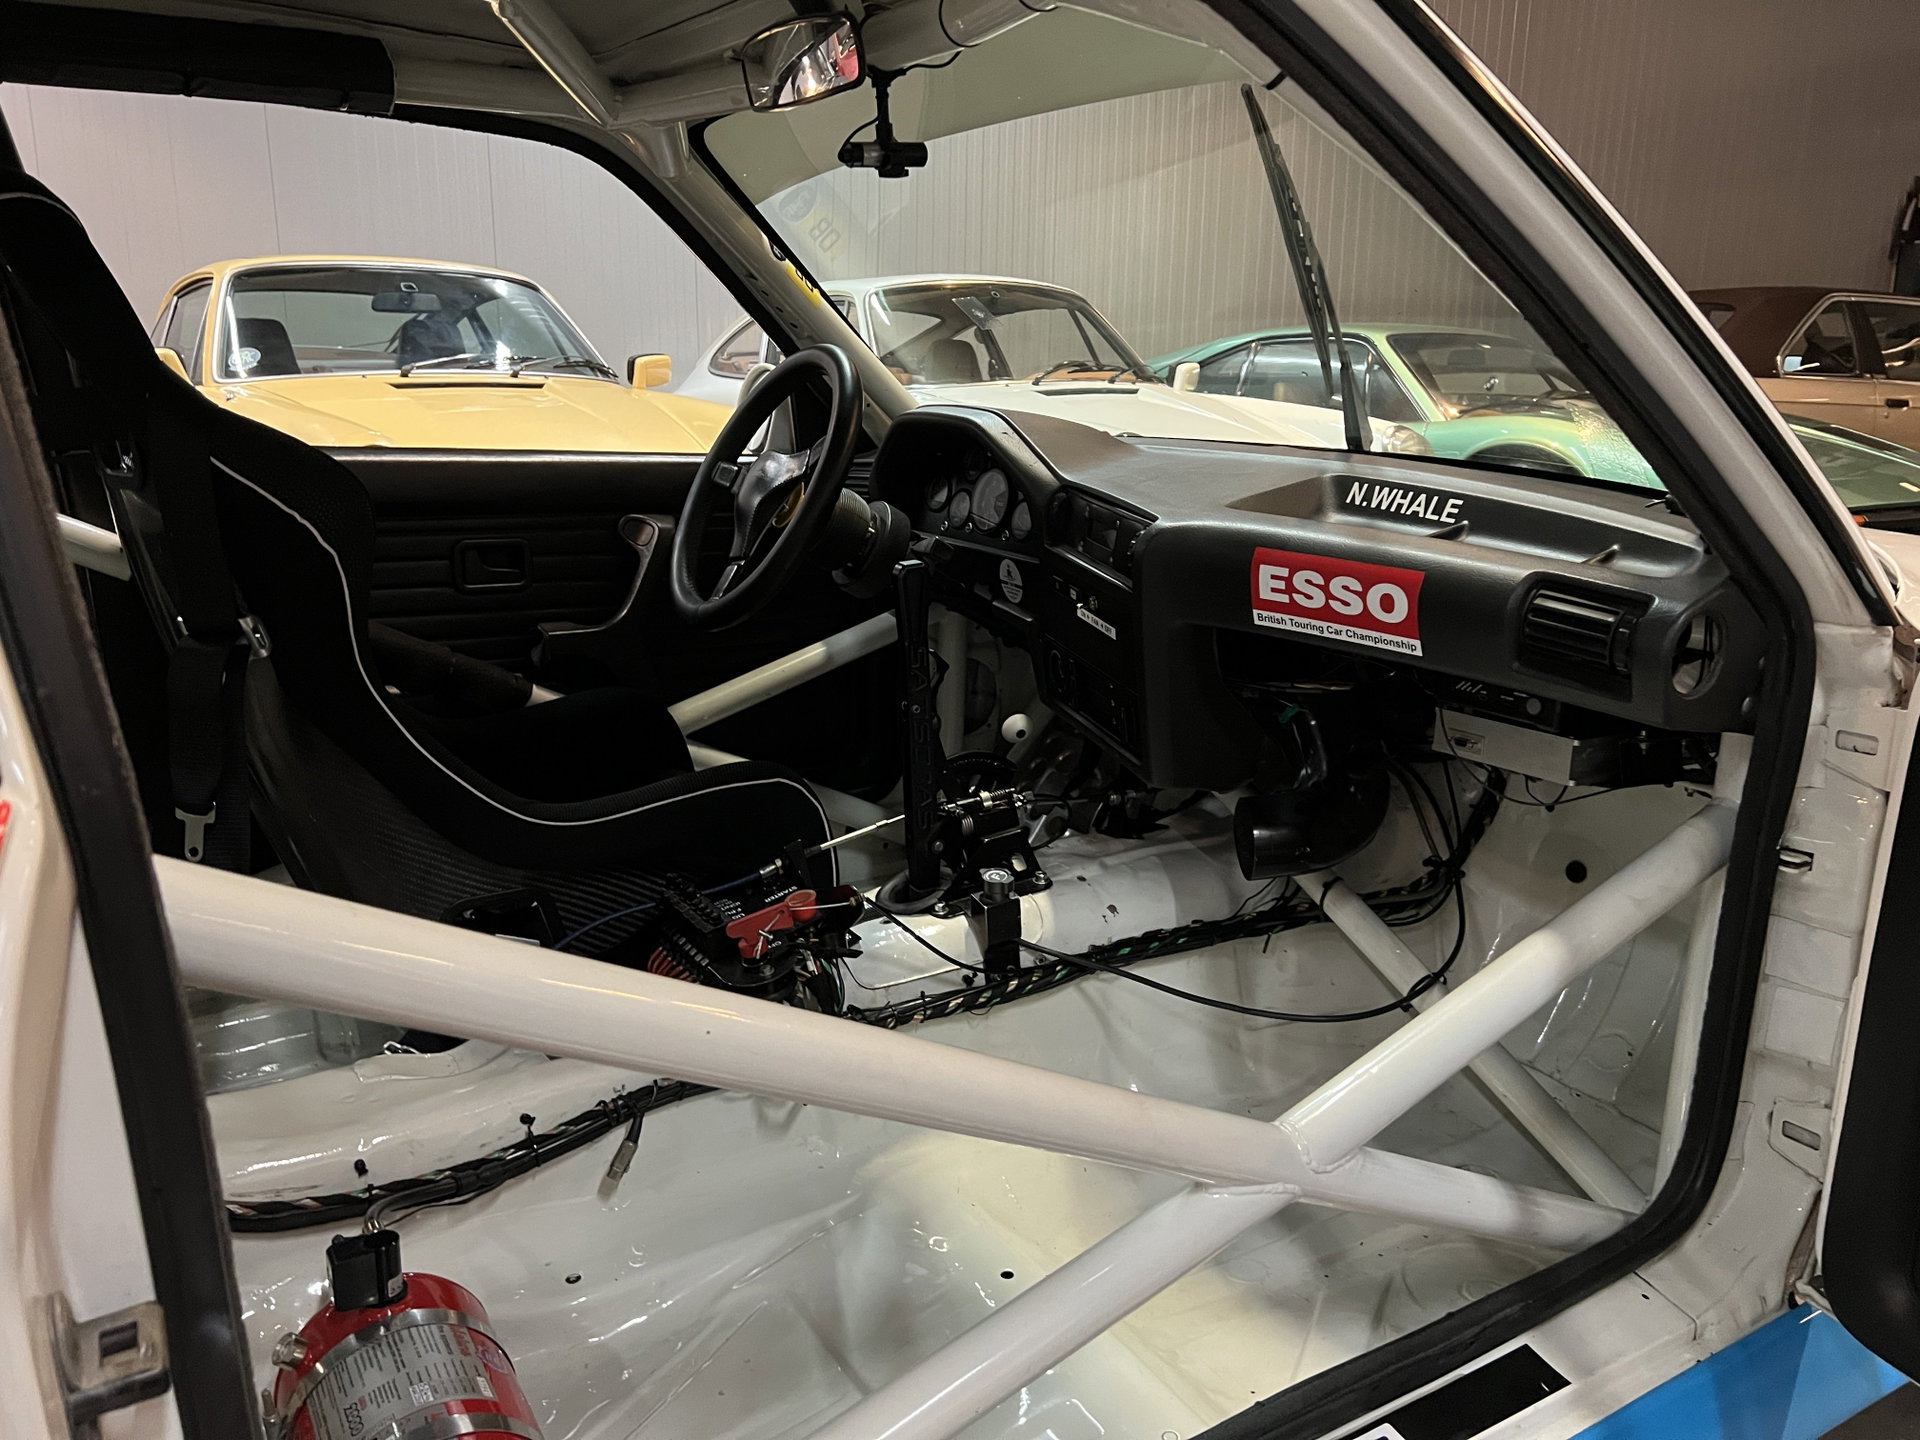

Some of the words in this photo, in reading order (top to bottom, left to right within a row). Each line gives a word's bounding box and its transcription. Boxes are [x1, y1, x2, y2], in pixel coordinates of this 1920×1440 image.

[1345, 481, 1464, 523] N.WHALE
[1258, 564, 1409, 624] ESSO
[1257, 612, 1287, 627] British
[1288, 616, 1324, 635] Touring
[1326, 624, 1343, 637] Car
[1345, 629, 1417, 653] Championship
[764, 885, 798, 903] STARTER
